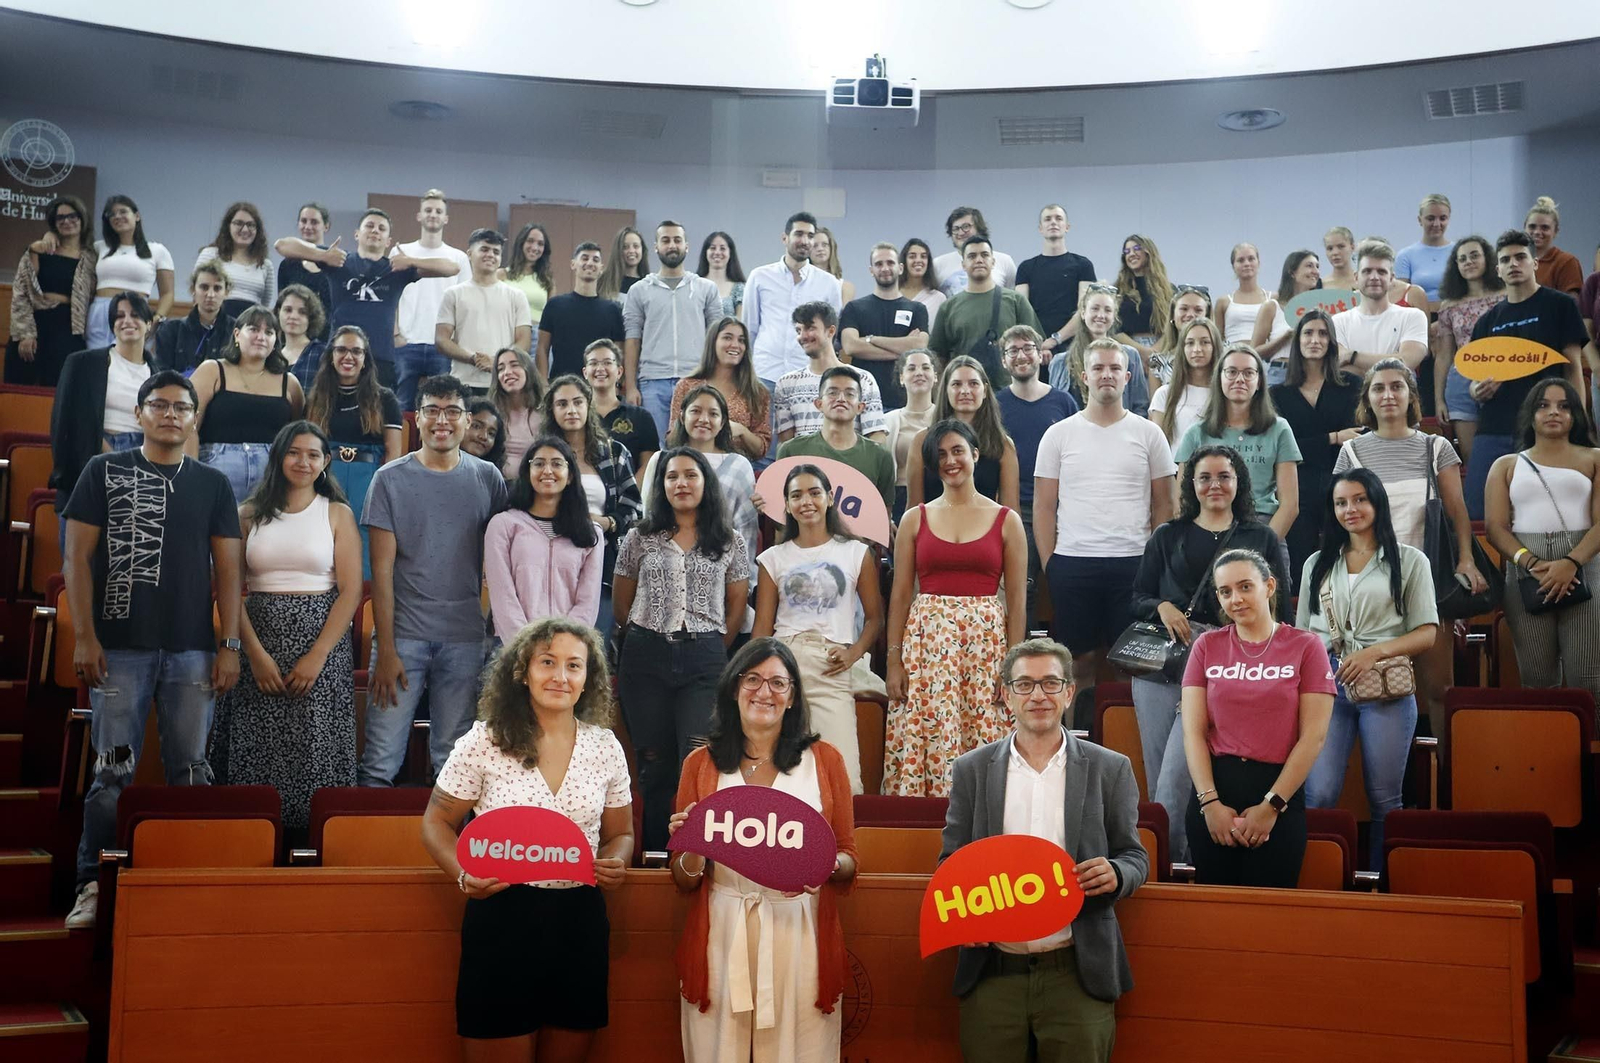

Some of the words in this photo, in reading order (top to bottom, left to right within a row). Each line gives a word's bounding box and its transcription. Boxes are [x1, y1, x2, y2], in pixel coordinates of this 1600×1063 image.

[2, 202, 19, 217] de
[1463, 353, 1505, 363] Dobro
[833, 485, 862, 518] la
[1205, 661, 1295, 681] adidas
[704, 809, 804, 850] Hola
[469, 837, 581, 864] Welcome
[933, 872, 1046, 923] Hallo
